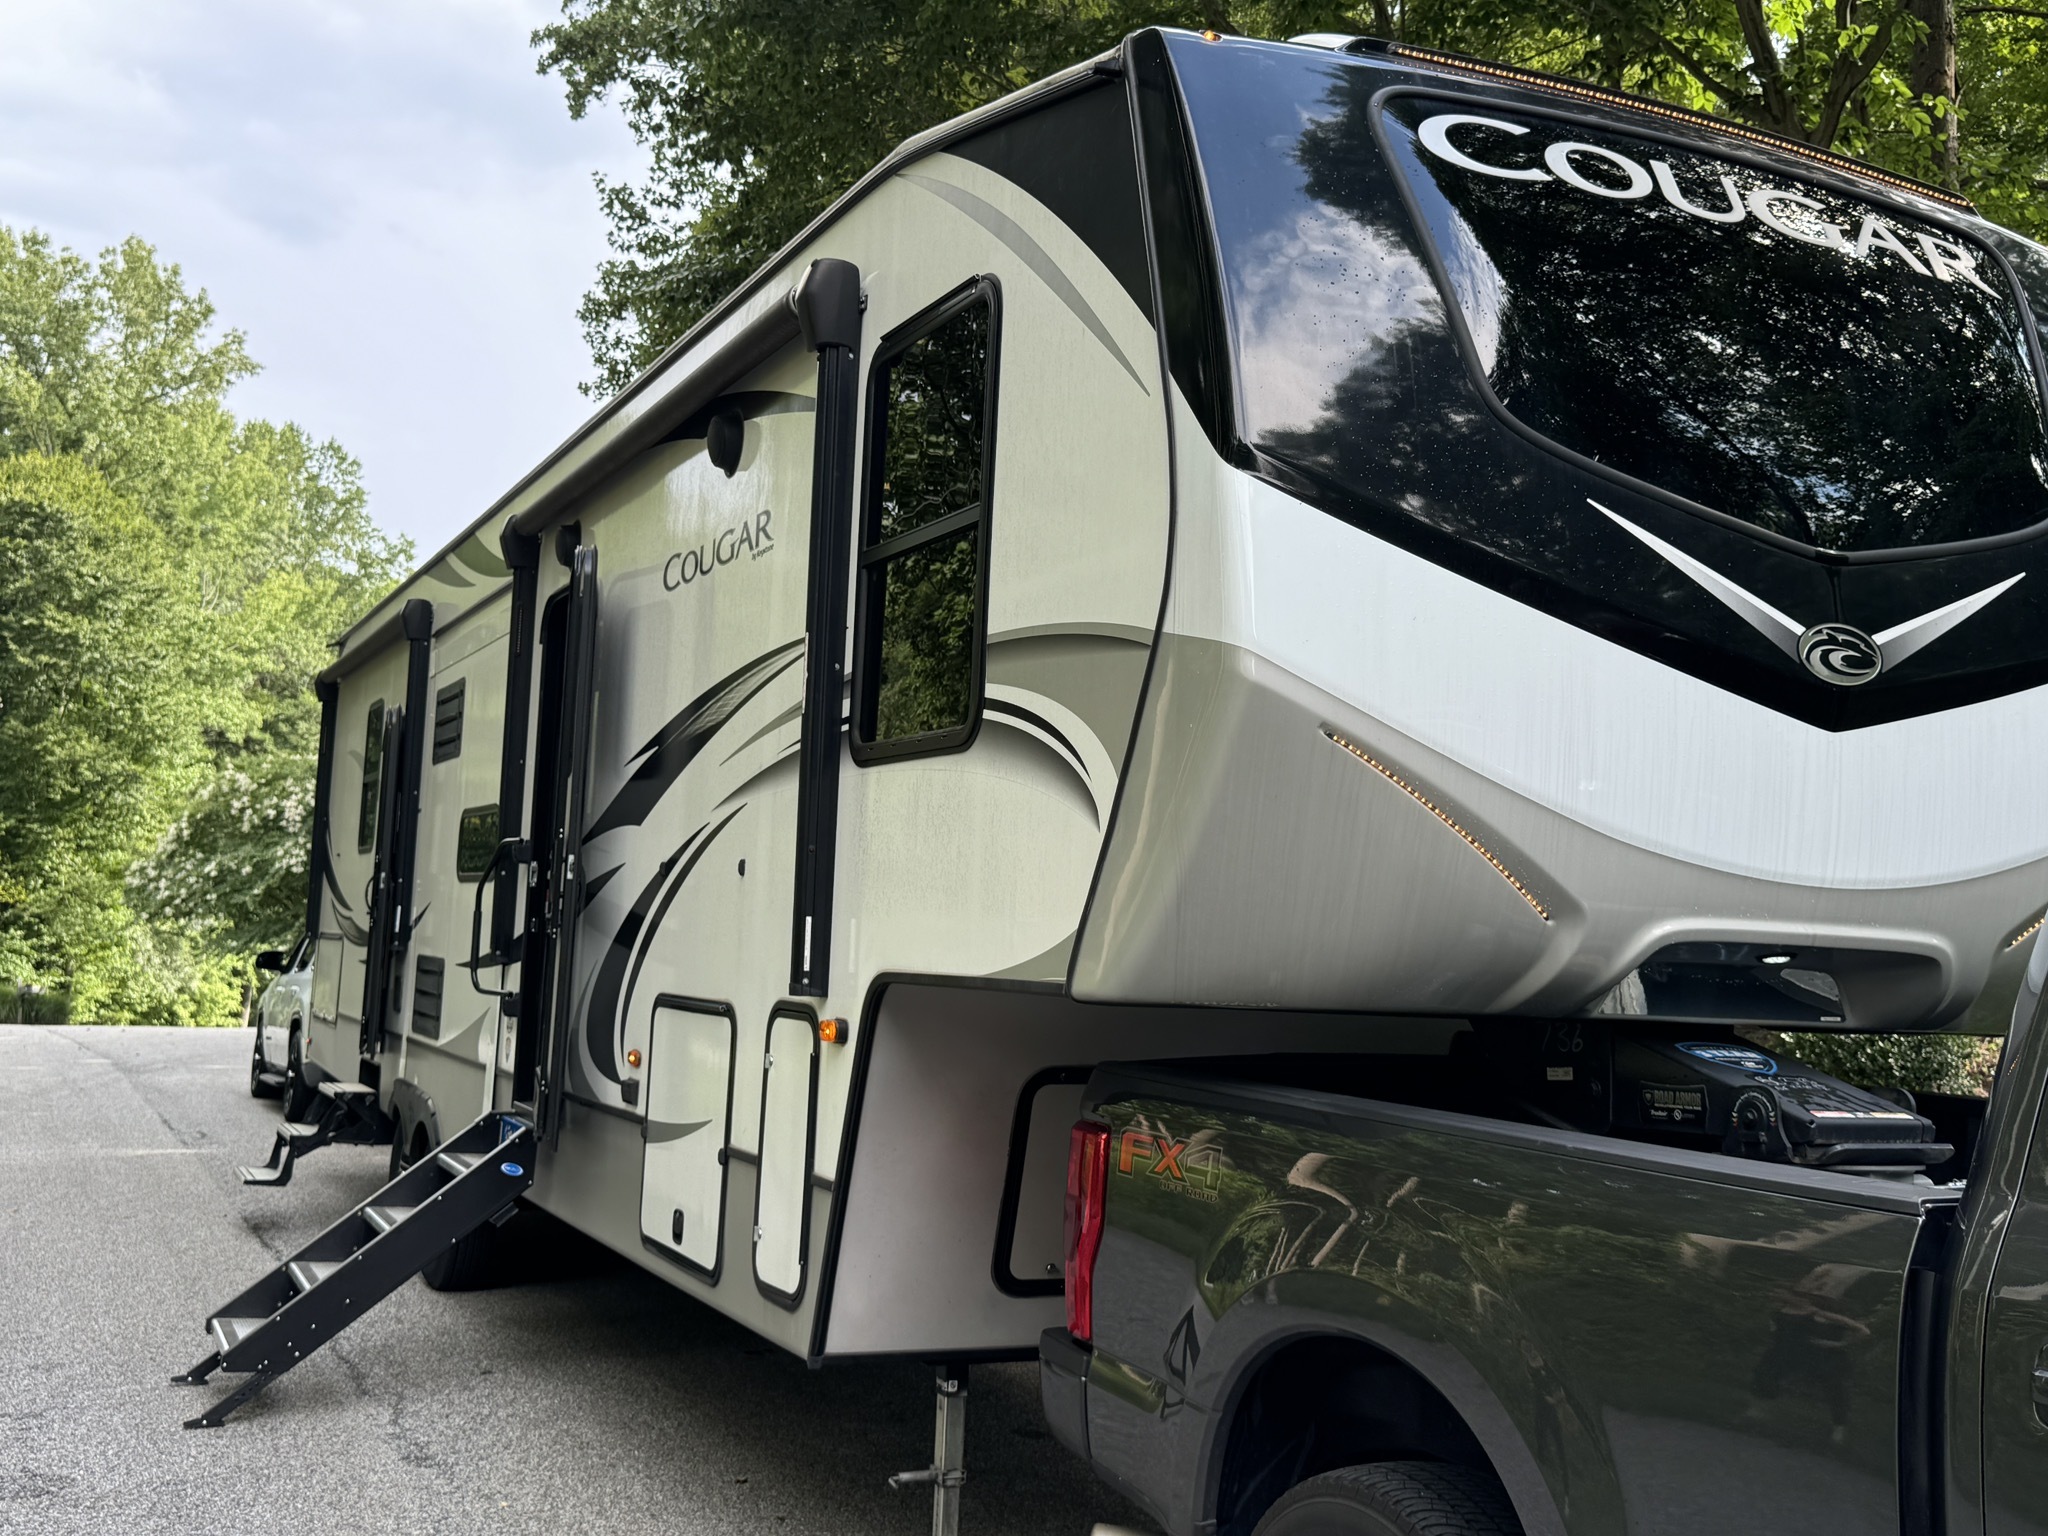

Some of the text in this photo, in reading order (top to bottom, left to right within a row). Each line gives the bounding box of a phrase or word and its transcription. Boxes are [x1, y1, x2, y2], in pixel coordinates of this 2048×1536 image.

[1417, 113, 2003, 300] COUGAR
[663, 509, 774, 592] COUGAR
[1117, 1126, 1223, 1193] FX4
[1159, 1179, 1219, 1203] OFF ROAD
